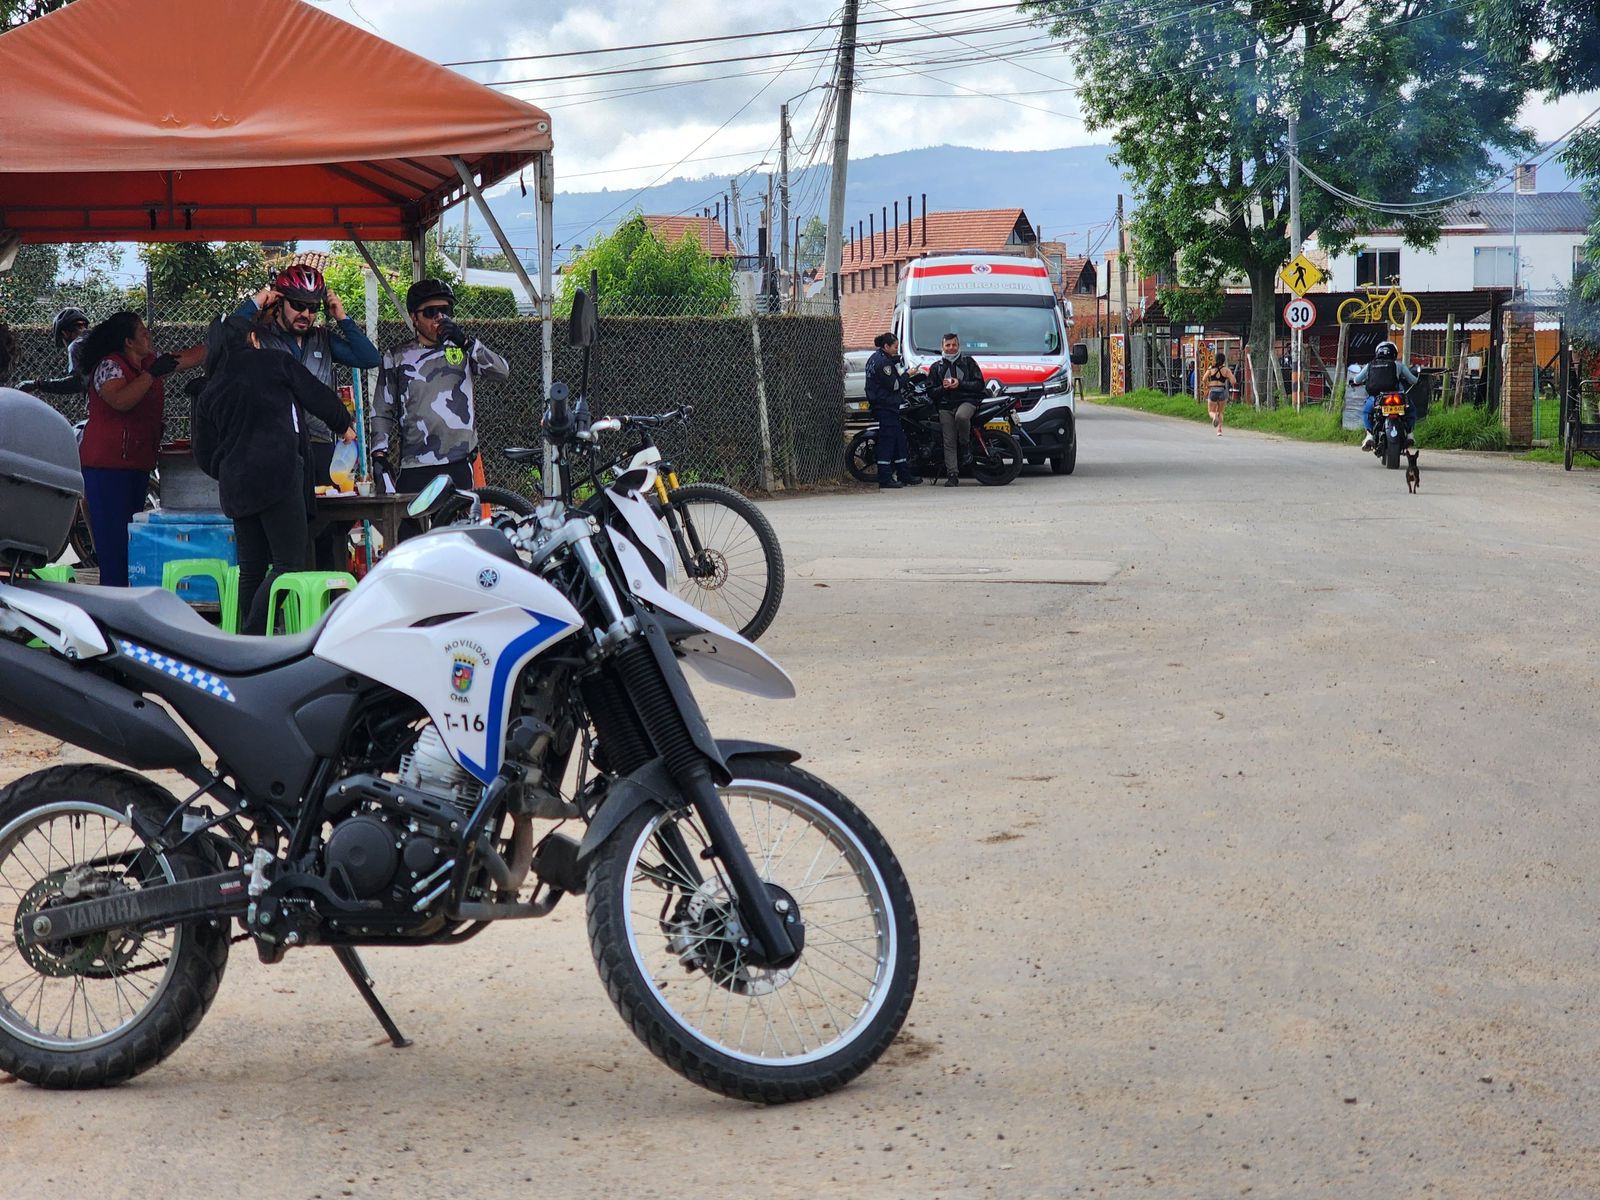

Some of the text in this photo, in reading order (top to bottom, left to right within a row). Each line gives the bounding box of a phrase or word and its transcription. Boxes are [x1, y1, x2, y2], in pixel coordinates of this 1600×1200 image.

[1291, 306, 1310, 322] 30
[443, 639, 490, 666] MOVILIDAD
[443, 712, 485, 732] T-16
[65, 897, 142, 929] YAMAHA
